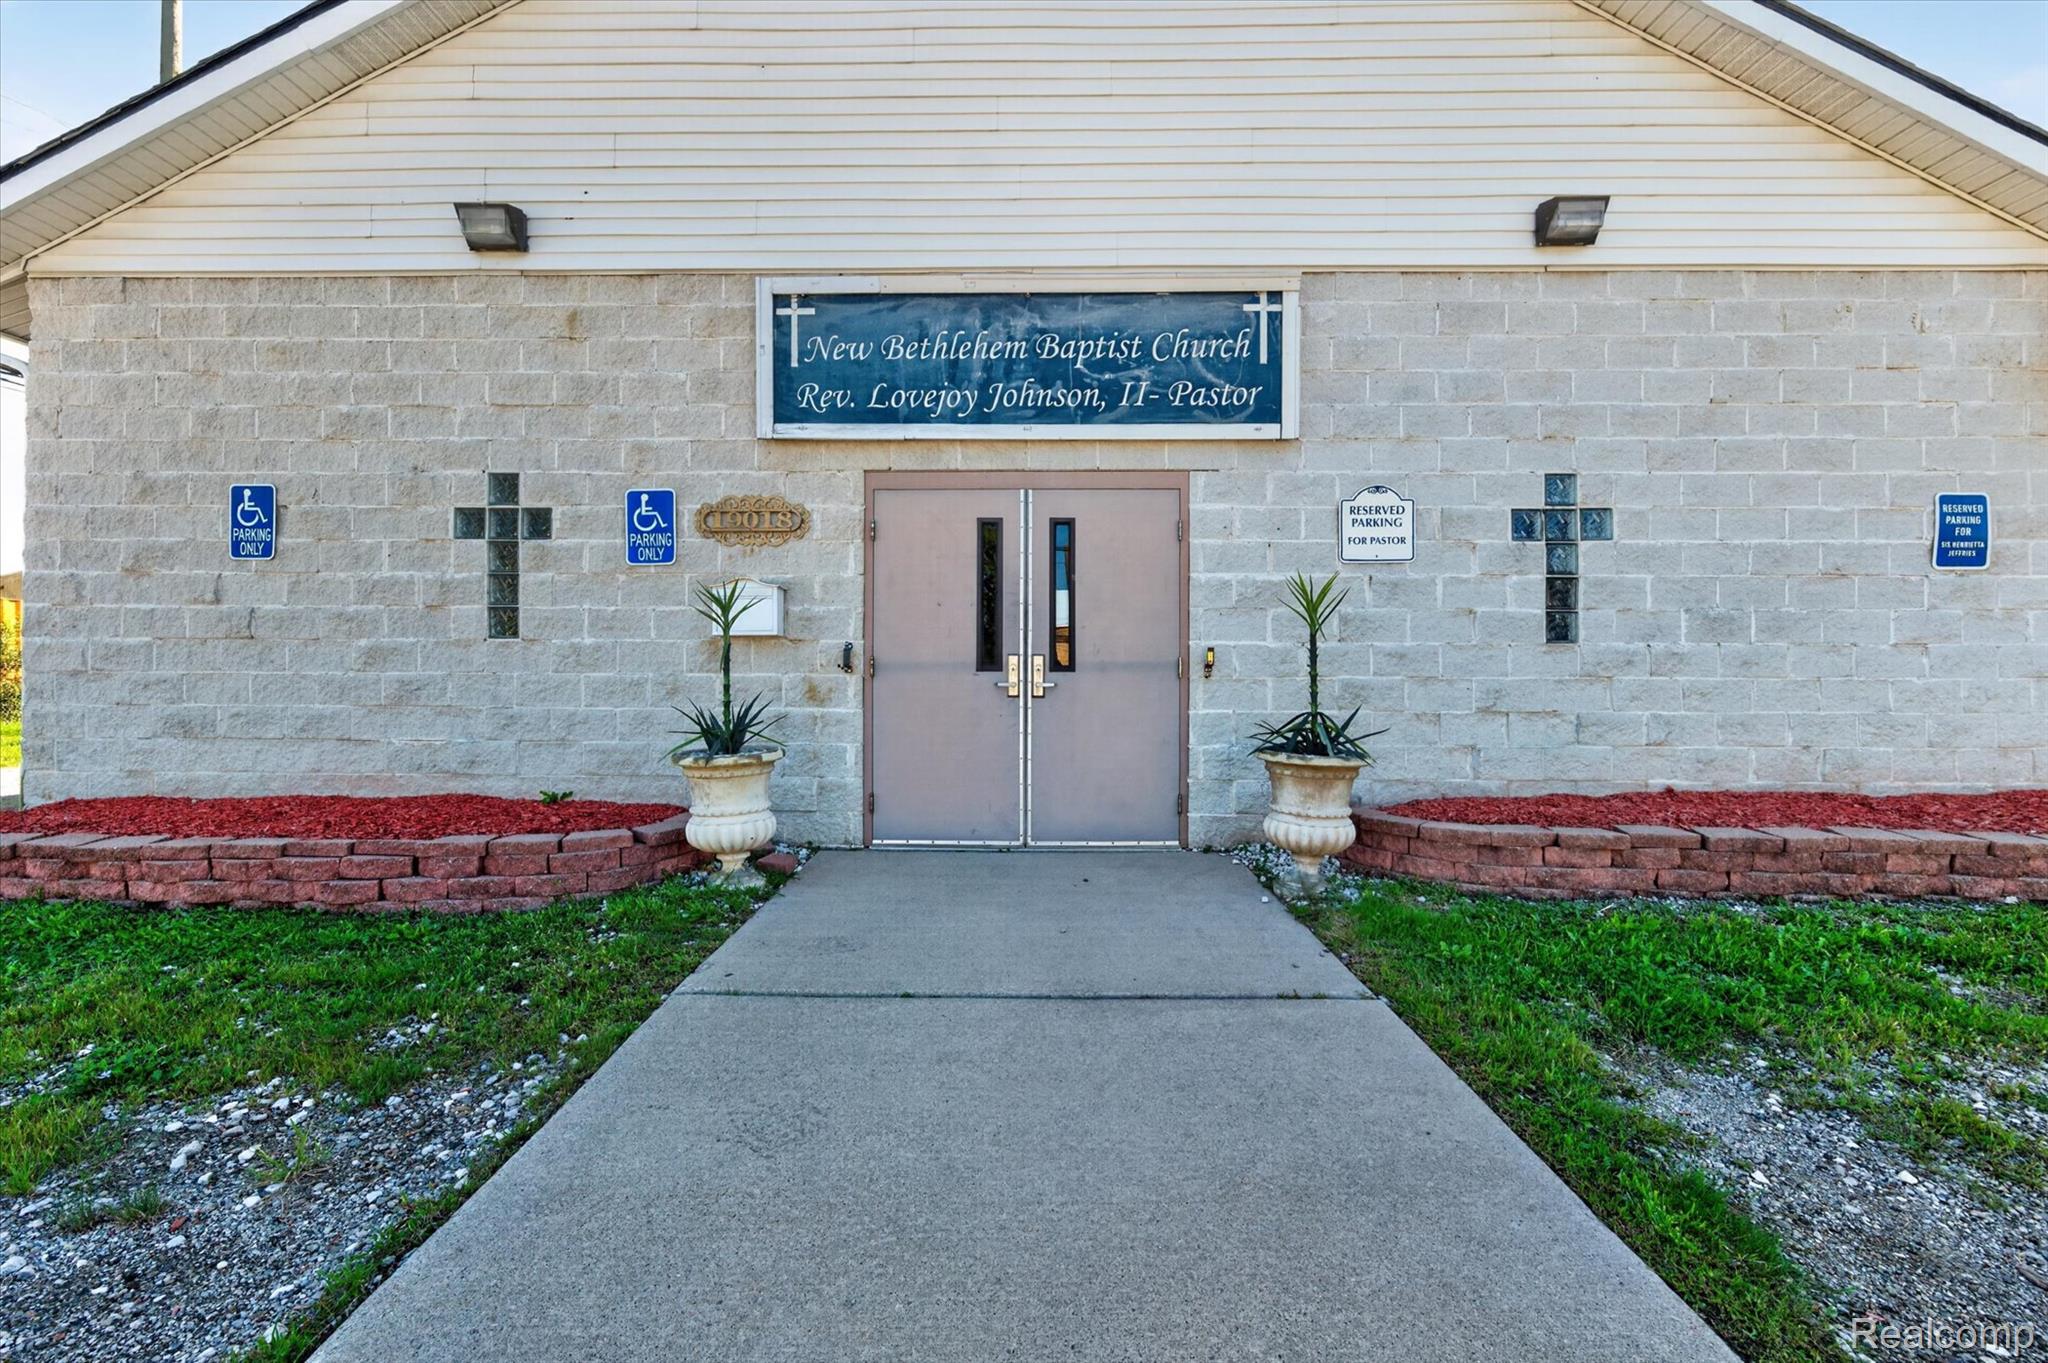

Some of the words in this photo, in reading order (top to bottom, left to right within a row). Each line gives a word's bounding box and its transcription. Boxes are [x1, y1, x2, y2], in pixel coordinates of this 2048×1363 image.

[804, 335, 874, 363] New
[880, 330, 1029, 360] Bethlehem
[1035, 331, 1142, 369] Baptist
[1152, 328, 1251, 362] Church
[797, 382, 855, 413] Rev.
[866, 381, 978, 418] Lovejoy
[983, 378, 1107, 413] Johnson,
[1168, 380, 1264, 407] Pastor
[1349, 505, 1406, 516] RESERVED
[1942, 504, 1984, 513] RESERVED
[712, 511, 793, 529] 19018
[1351, 517, 1403, 528] PARKING
[1945, 515, 1982, 525] PARKING
[232, 528, 272, 541] PARKING
[1954, 527, 1972, 536] FOR
[629, 532, 672, 547] PARKING
[1347, 536, 1367, 545] FOR
[1369, 536, 1407, 545] PASTOR
[240, 542, 265, 555] ONLY
[638, 547, 665, 561] ONLY
